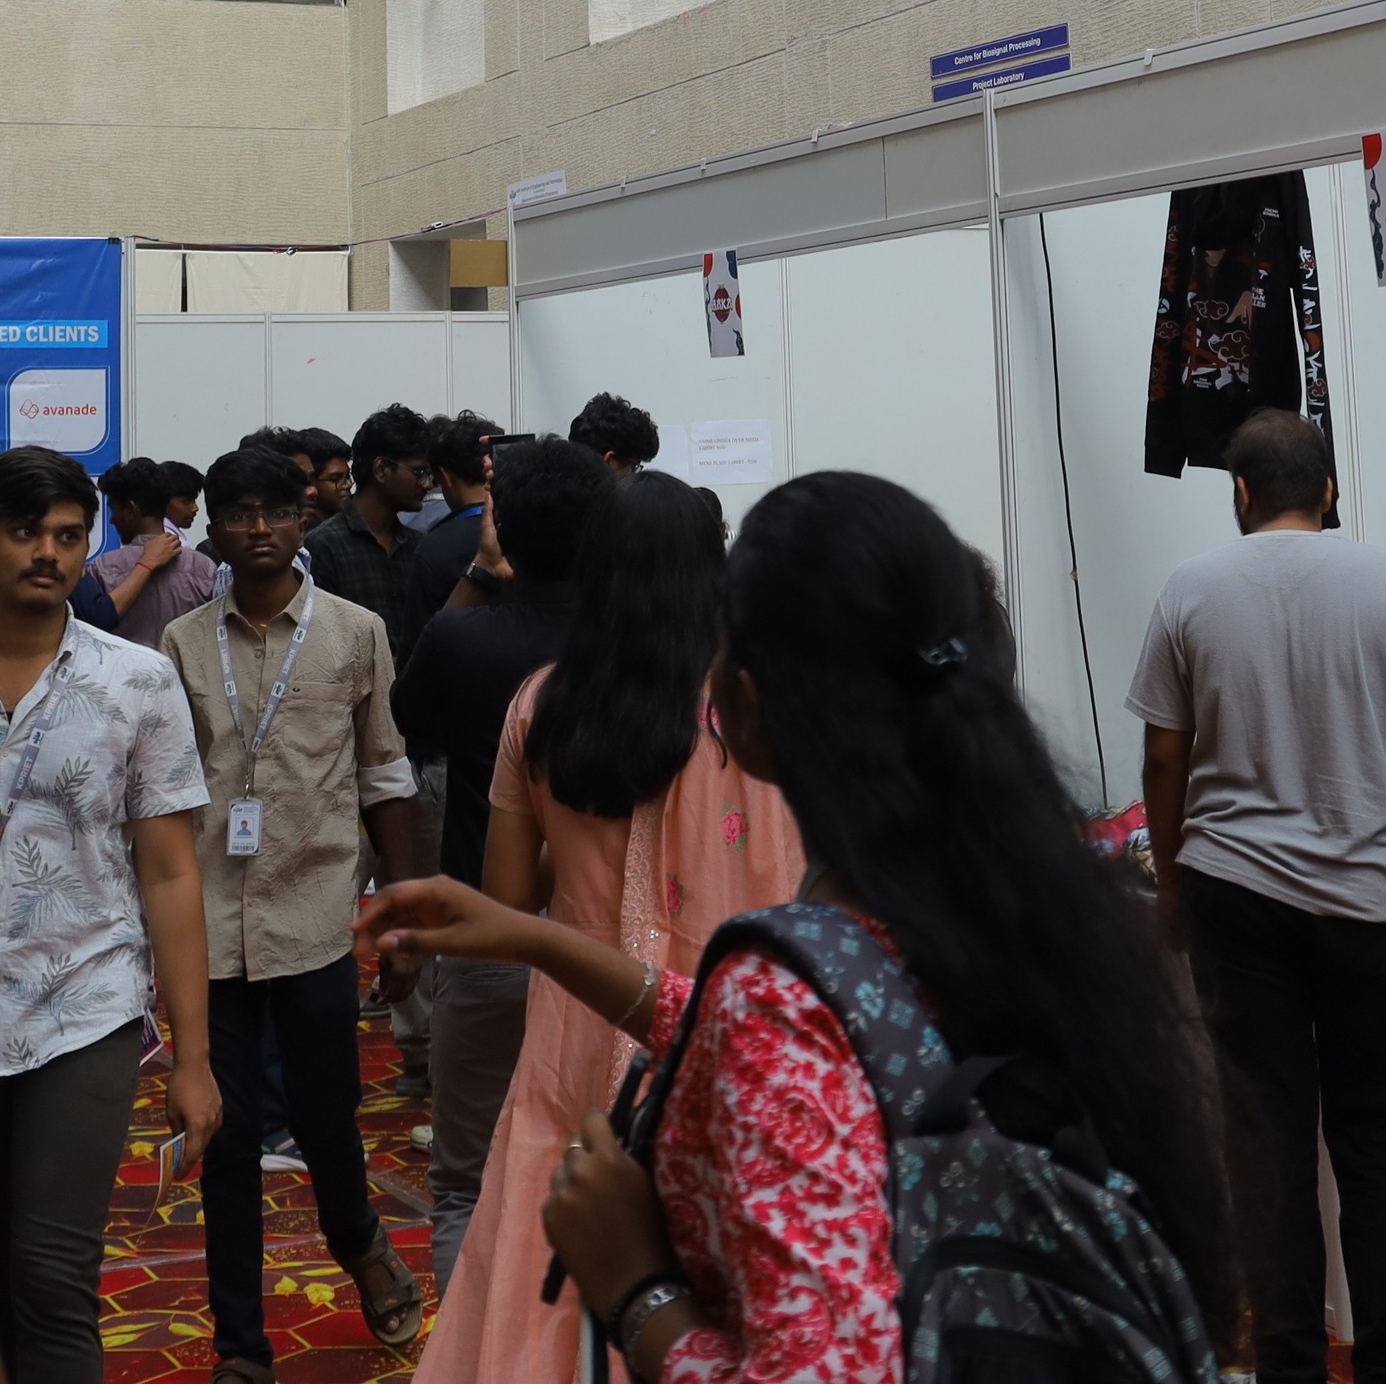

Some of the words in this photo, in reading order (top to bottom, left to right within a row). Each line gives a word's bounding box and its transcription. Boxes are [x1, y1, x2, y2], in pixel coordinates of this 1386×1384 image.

[955, 54, 973, 65] Centre
[973, 52, 981, 61] for
[982, 44, 1008, 60] Biosignal
[1009, 36, 1041, 52] Processing
[973, 78, 993, 91] Project
[993, 71, 1025, 86] Laboratory
[25, 326, 100, 342] CLIENTS
[43, 404, 97, 416] avanade
[281, 649, 297, 675] KPRIET
[260, 704, 274, 729] KPRIET
